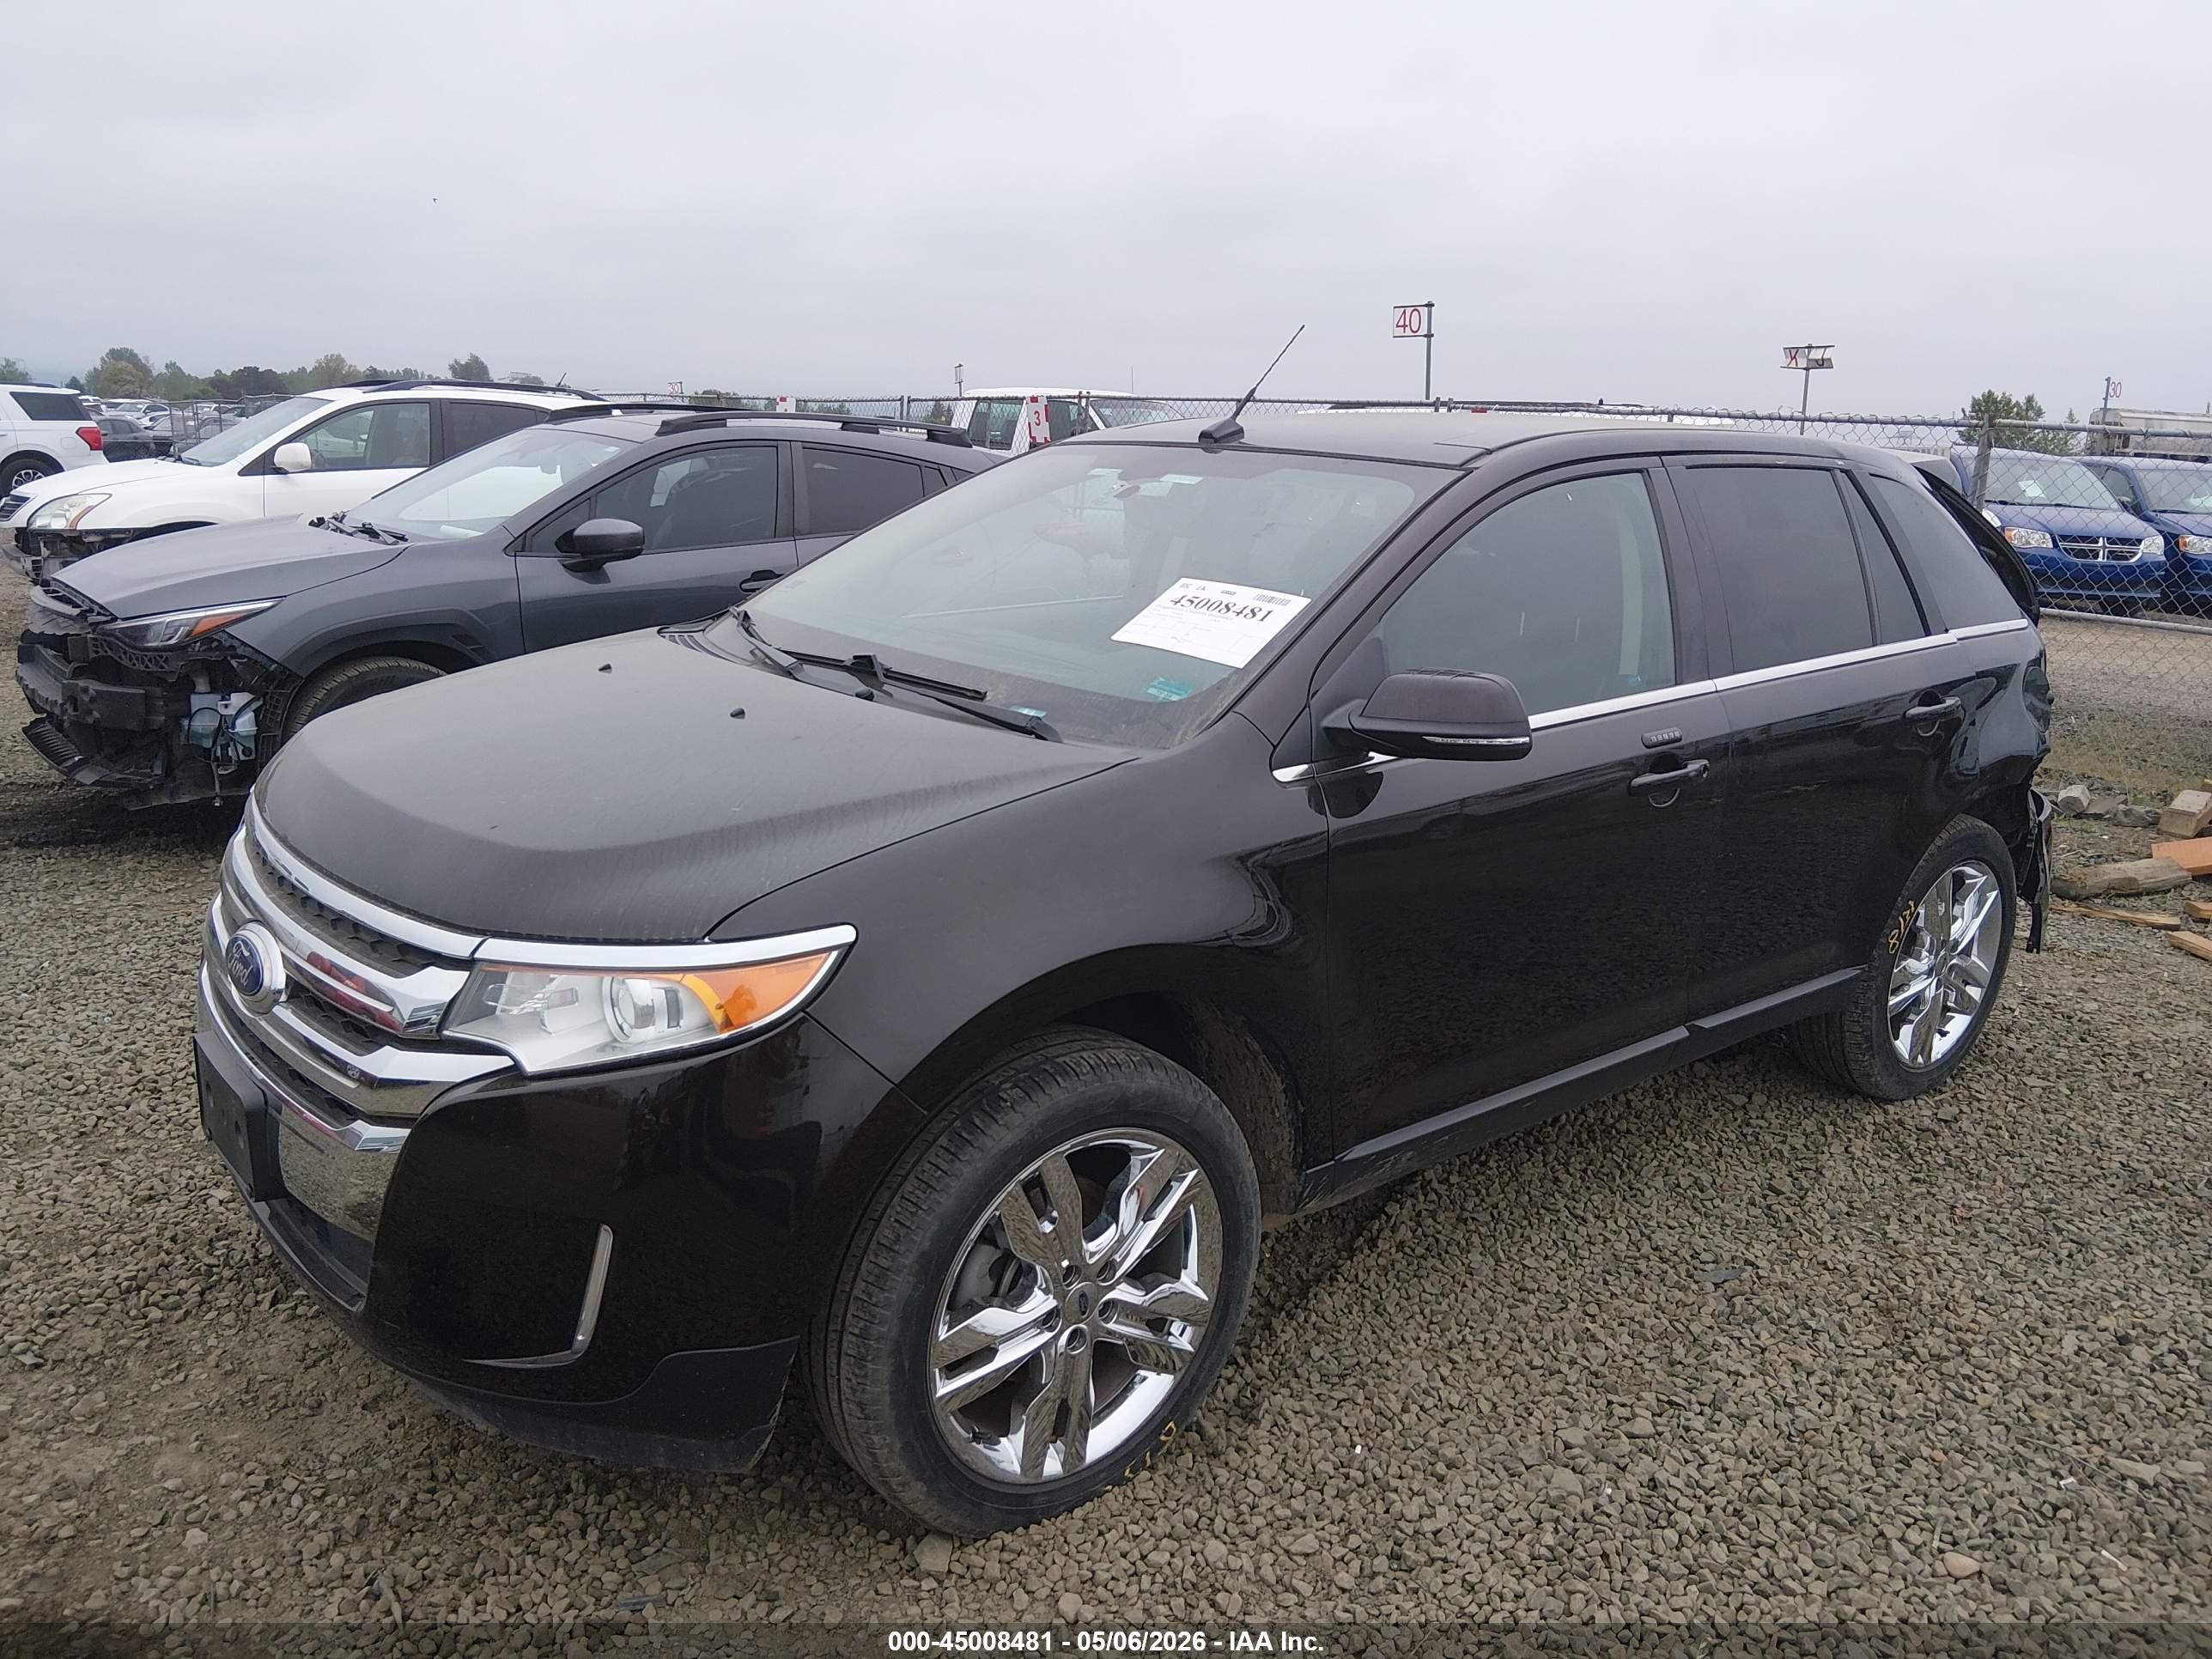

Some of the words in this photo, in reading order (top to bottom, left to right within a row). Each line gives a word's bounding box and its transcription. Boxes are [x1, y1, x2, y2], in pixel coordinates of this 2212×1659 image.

[1395, 308, 1422, 334] 40
[2109, 381, 2122, 398] 30
[1033, 410, 1042, 427] 3
[1170, 594, 1275, 623] 45008481
[228, 940, 254, 988] Ford
